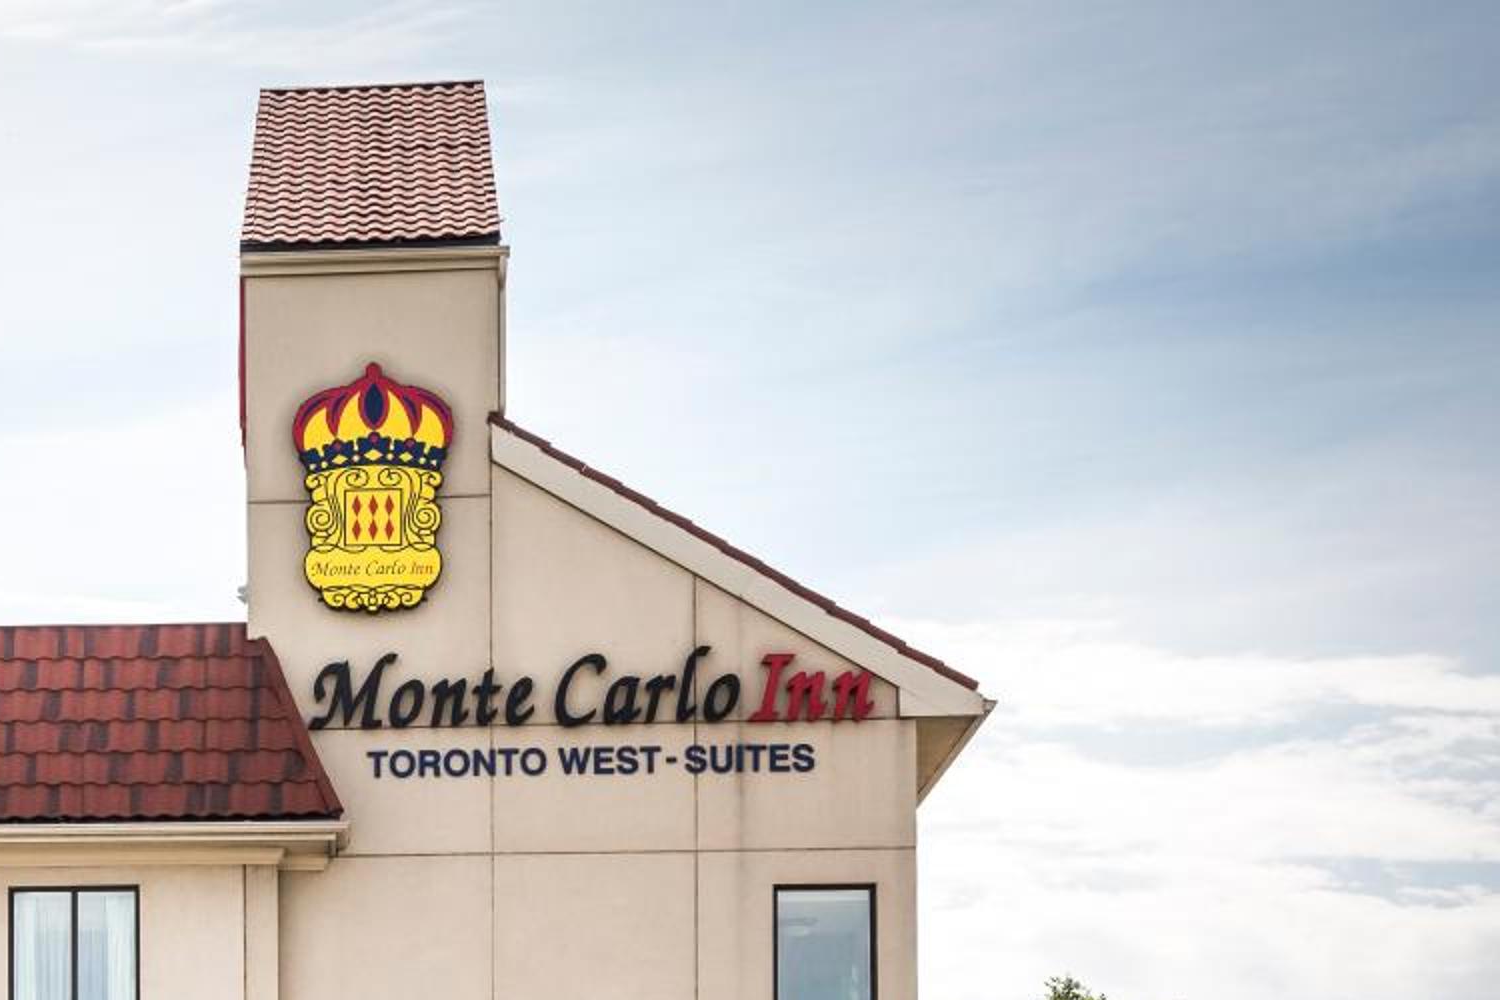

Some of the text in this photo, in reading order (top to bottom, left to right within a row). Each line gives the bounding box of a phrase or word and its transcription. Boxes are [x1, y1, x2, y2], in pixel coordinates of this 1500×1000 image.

[311, 560, 434, 577] Monte Carlo Inn
[308, 645, 876, 730] Monte Carlo Inn
[366, 748, 548, 779] TORONTO
